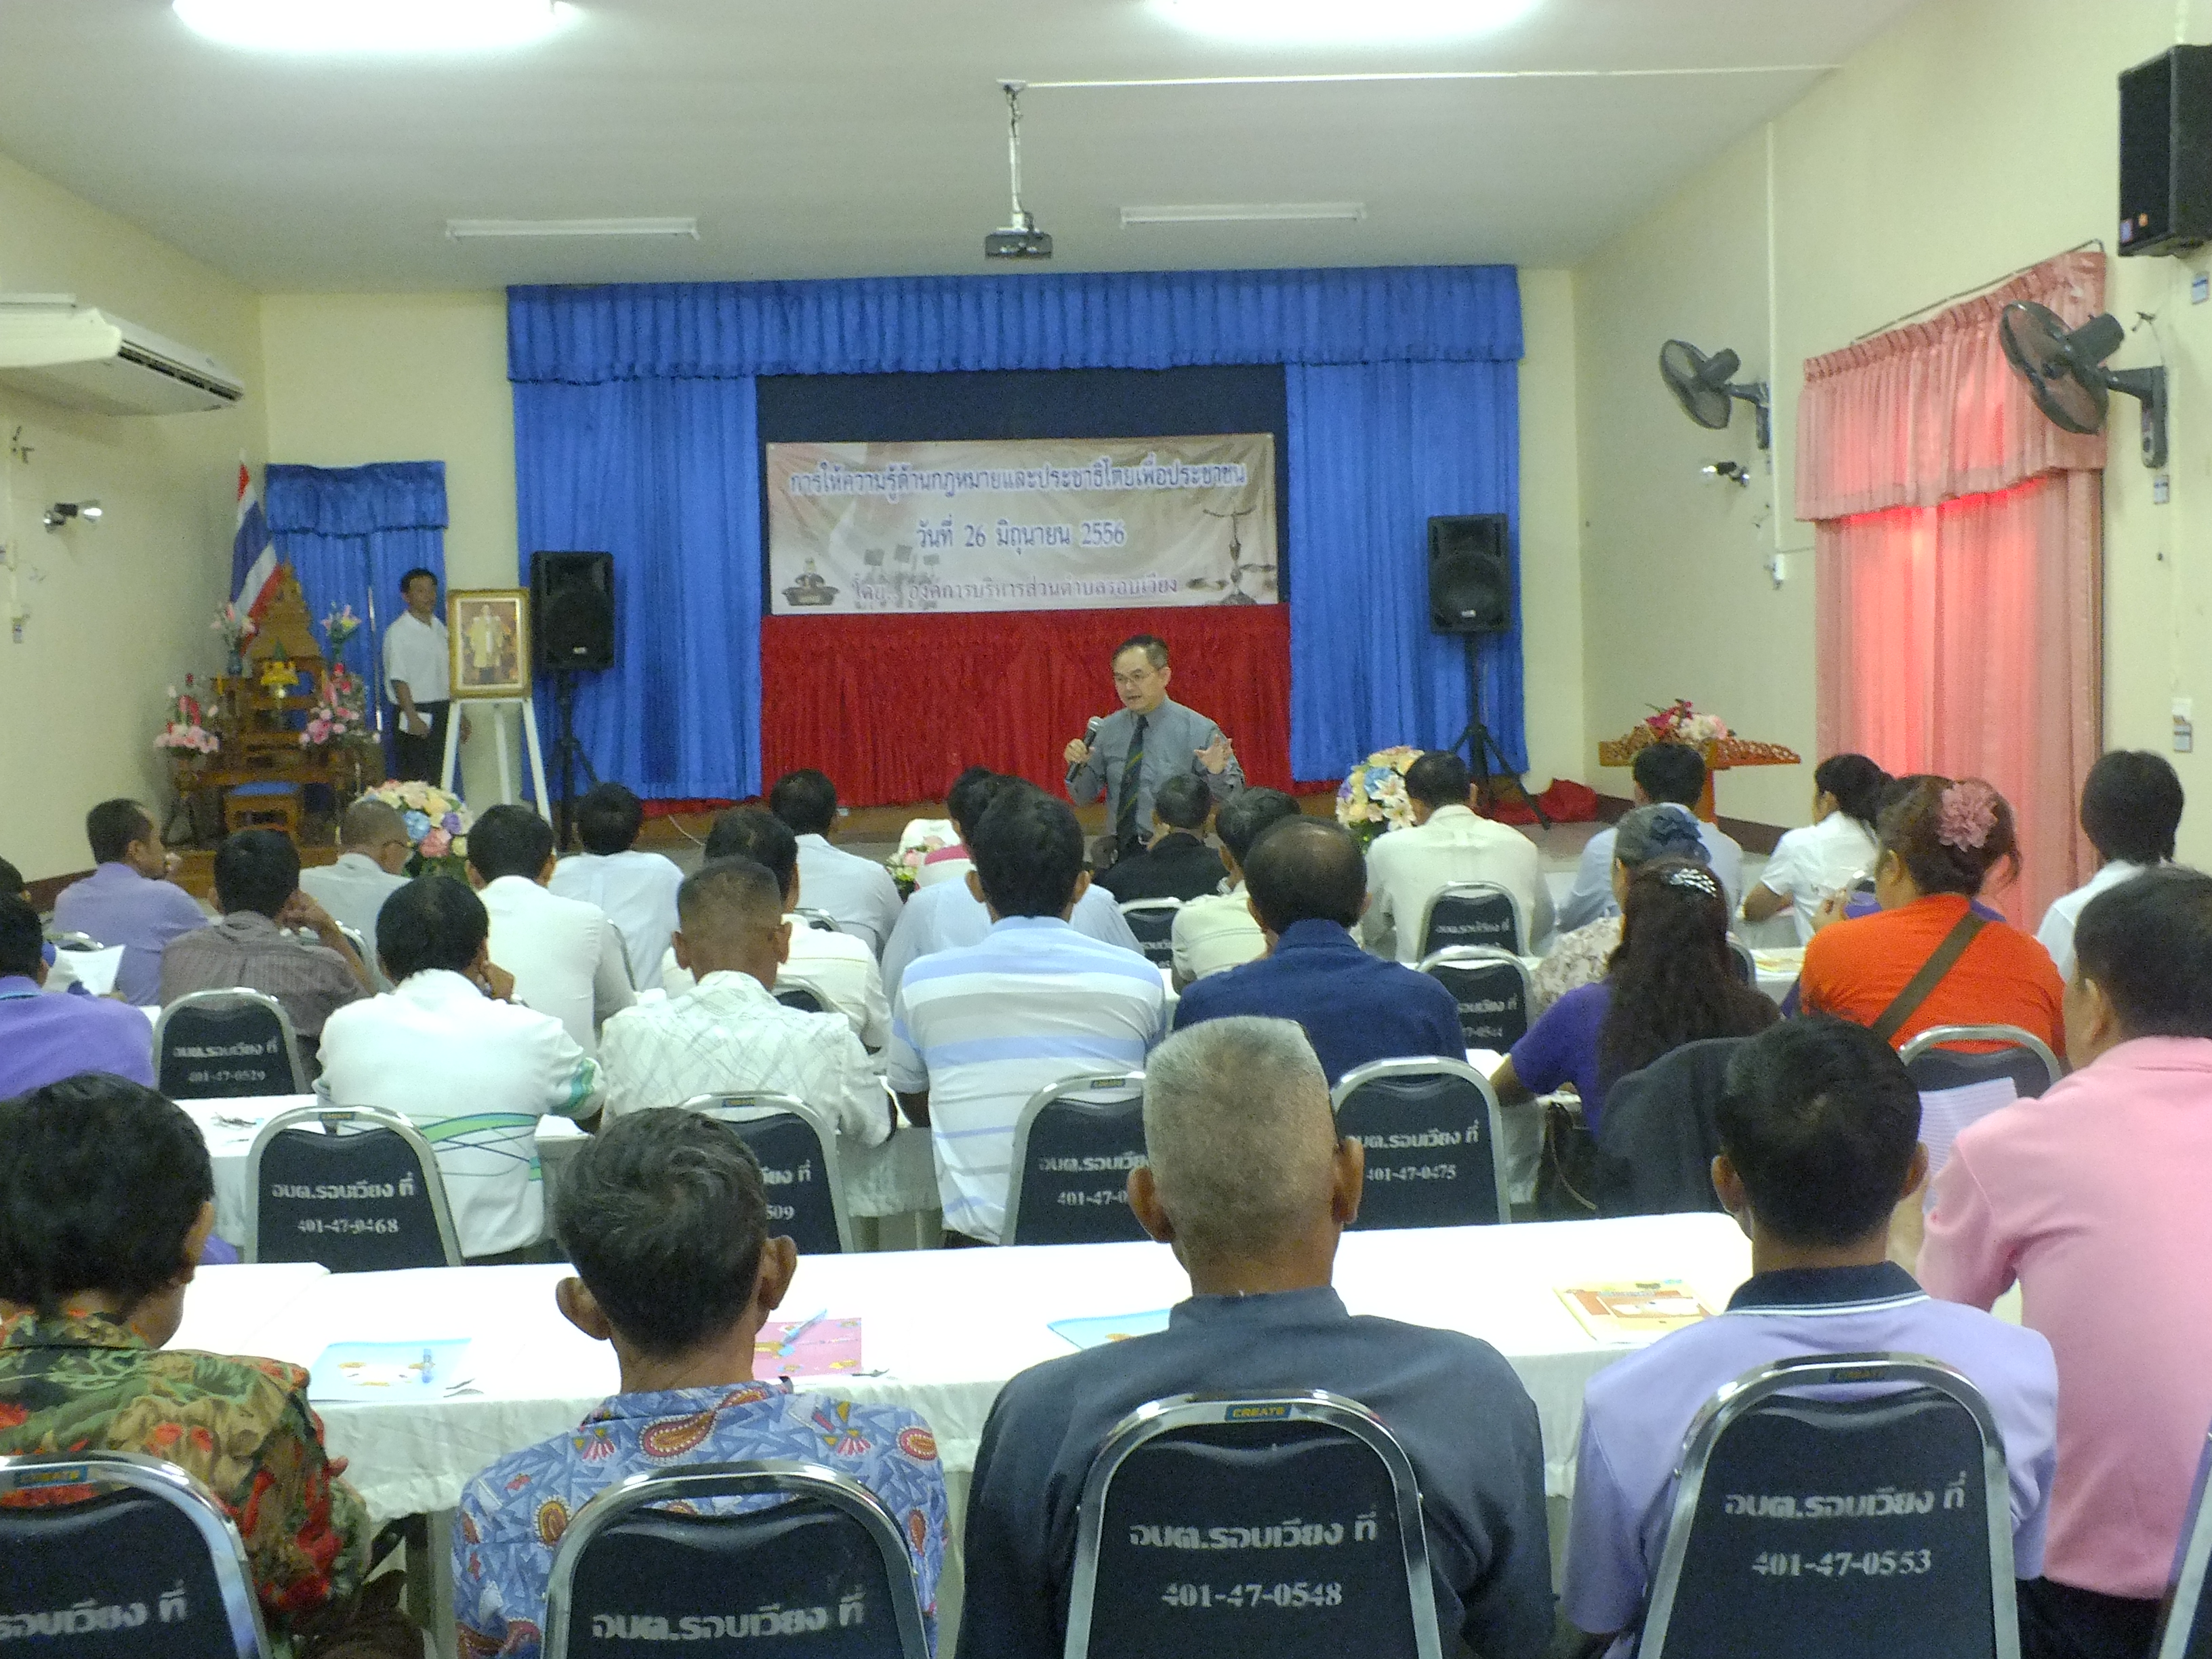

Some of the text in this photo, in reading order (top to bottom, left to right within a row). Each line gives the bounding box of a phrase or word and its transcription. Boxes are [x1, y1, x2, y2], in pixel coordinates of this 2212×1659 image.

[917, 514, 1125, 556] วันที่ 26 มิถุนายน 2556
[1465, 1119, 1479, 1143] ที่
[798, 1160, 811, 1182] ที่
[272, 1171, 415, 1199] อบต.รอบเวียง ที่
[1058, 1191, 1128, 1206] 401-47-0
[297, 1218, 399, 1235] 401-47-0468
[1725, 1471, 1966, 1518] อบต.รอบเวียง ที่
[1130, 1503, 1377, 1549] อบต.รอบเวียง ที่
[1752, 1549, 1931, 1576] 401-47-0553
[1162, 1582, 1342, 1607] 401-47-0548
[0, 1579, 187, 1640] รอบเวียง ที่
[592, 1584, 865, 1641] อบต.รอบเวียง ที่
